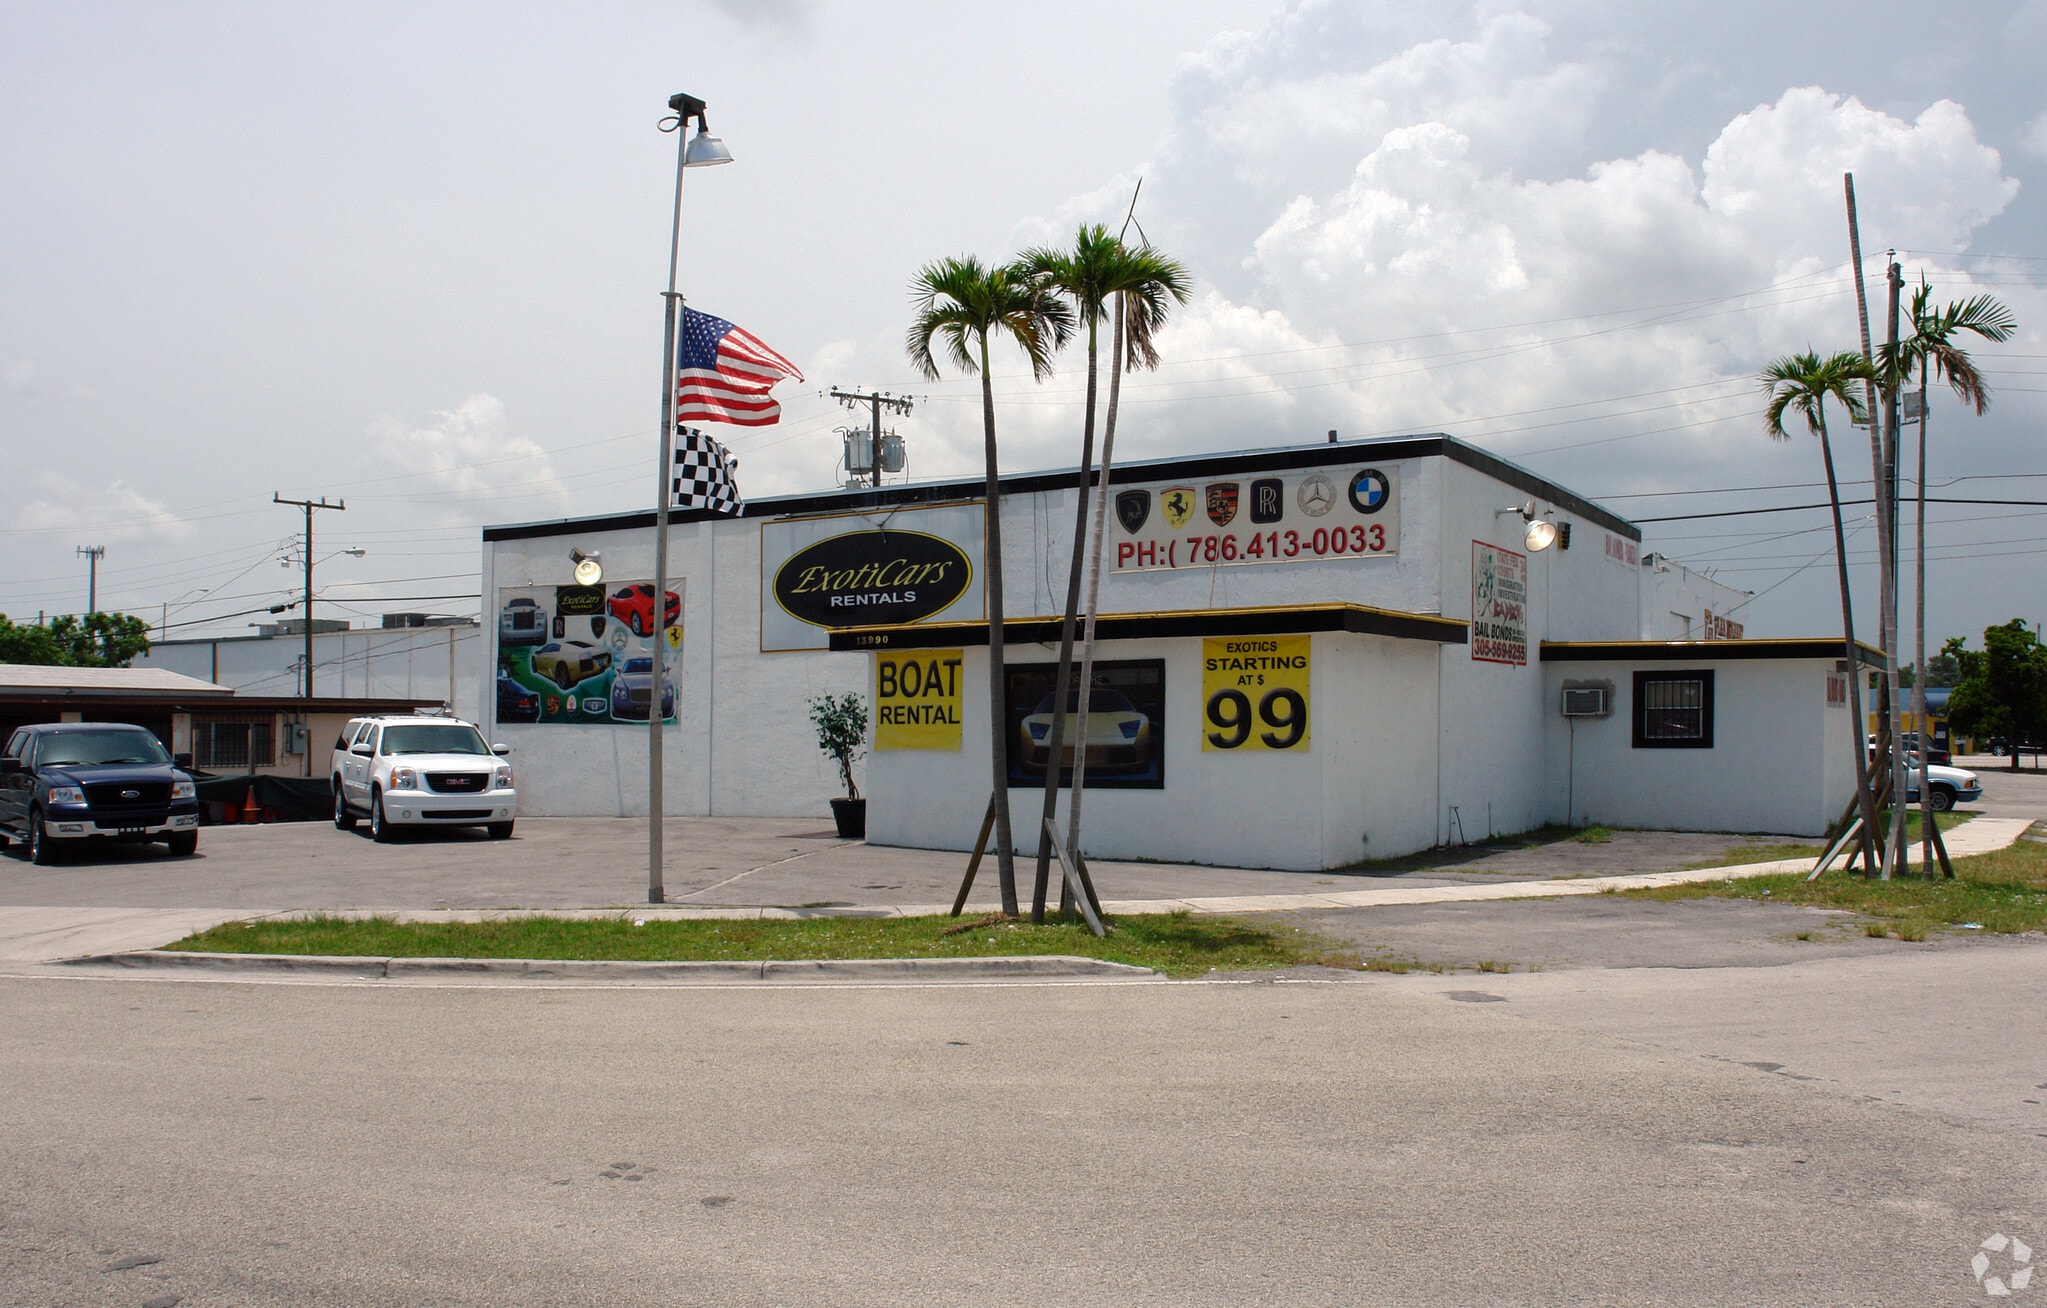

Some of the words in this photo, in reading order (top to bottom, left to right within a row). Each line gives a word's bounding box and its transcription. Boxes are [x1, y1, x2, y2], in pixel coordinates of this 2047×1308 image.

[1187, 524, 1386, 563] 786.413-0033
[790, 558, 953, 594] ExotiCars
[561, 594, 601, 605] ExotiCars
[830, 590, 917, 607] RENTALS
[1475, 620, 1490, 638] BAIL
[1491, 624, 1513, 641] BONDS
[1226, 641, 1277, 653] EXOTICS
[1474, 639, 1526, 661] 305-569-9255
[1206, 656, 1307, 671] STARTING
[880, 659, 962, 698] BOAT
[1237, 674, 1254, 686] AT
[1257, 673, 1265, 687] $
[880, 704, 961, 726] RENTAL
[1206, 687, 1307, 749] 99
